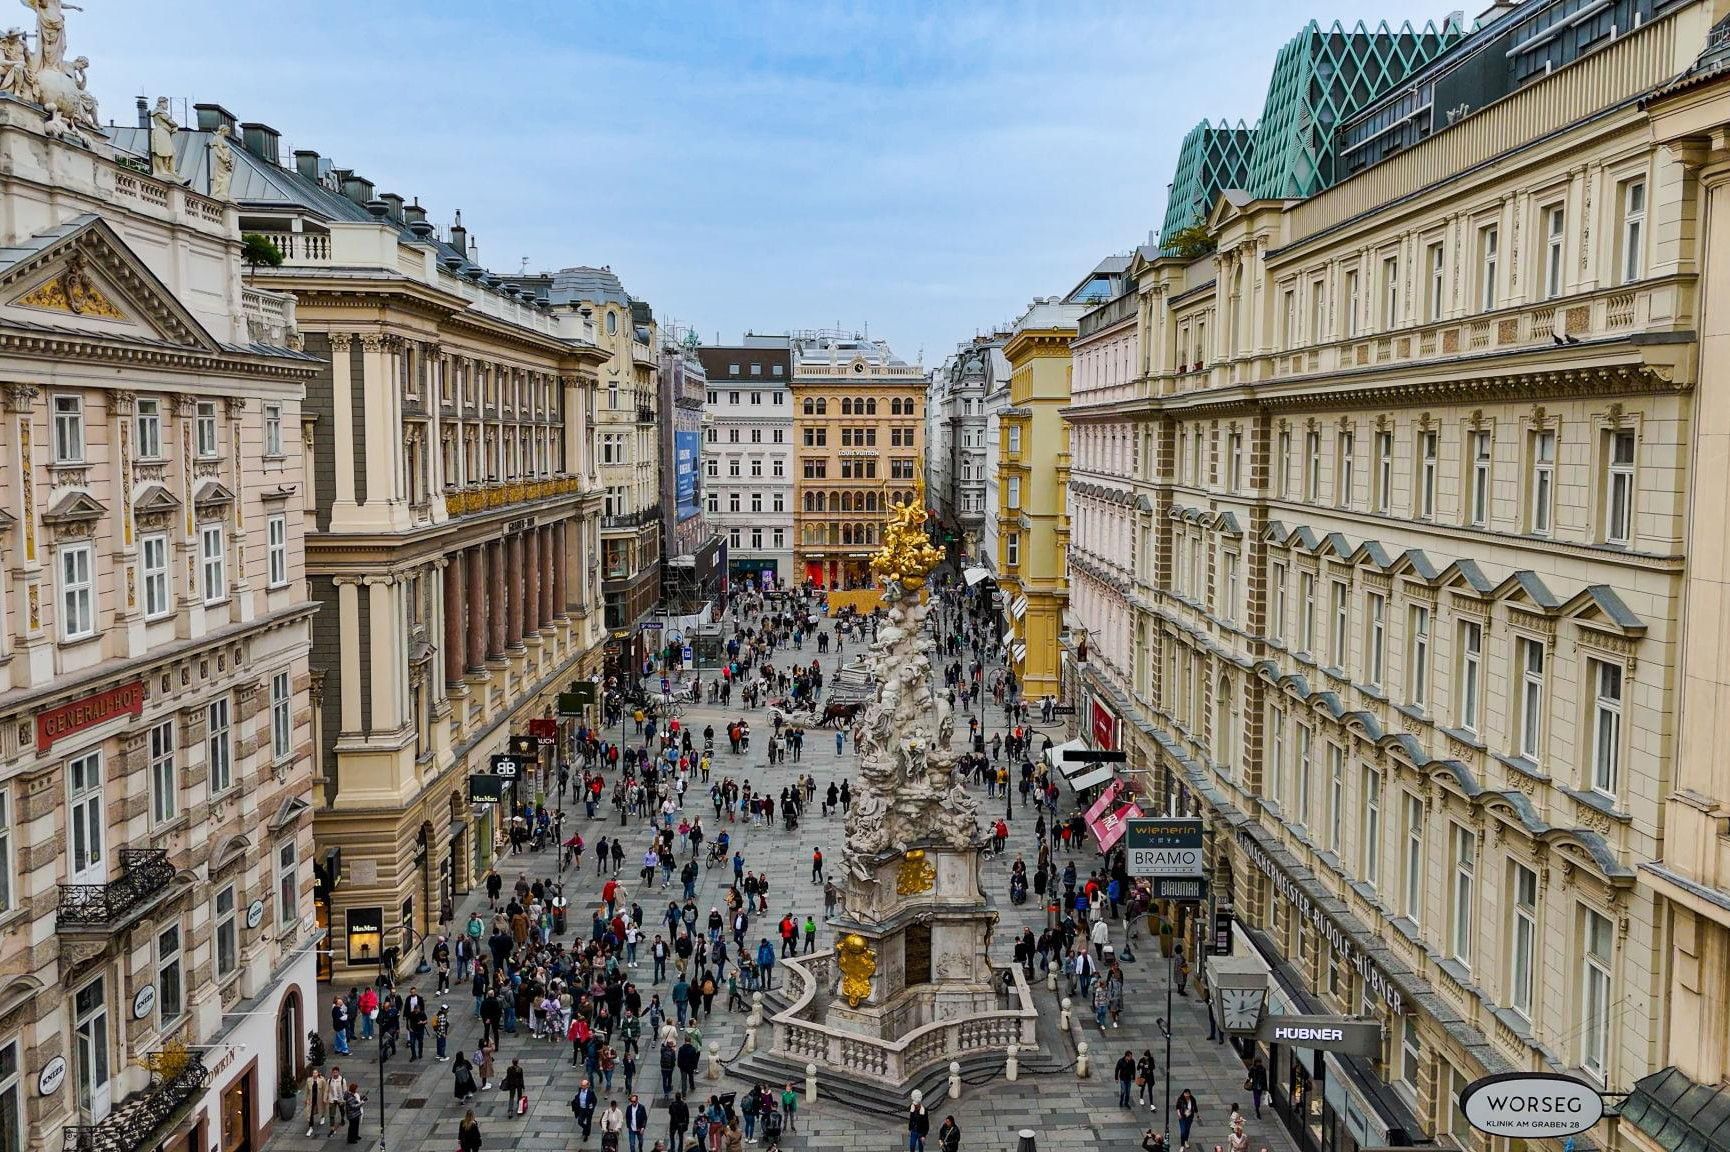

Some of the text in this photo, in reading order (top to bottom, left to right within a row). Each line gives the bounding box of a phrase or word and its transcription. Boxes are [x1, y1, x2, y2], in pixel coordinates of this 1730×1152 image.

[1135, 851, 1196, 864] BRAMO
[1312, 907, 1351, 958] RUDOLF
[42, 1064, 64, 1086] KNIZE
[1487, 1095, 1582, 1113] WORSEG
[1486, 1120, 1580, 1129] KLINIK AM GRABEN 28
